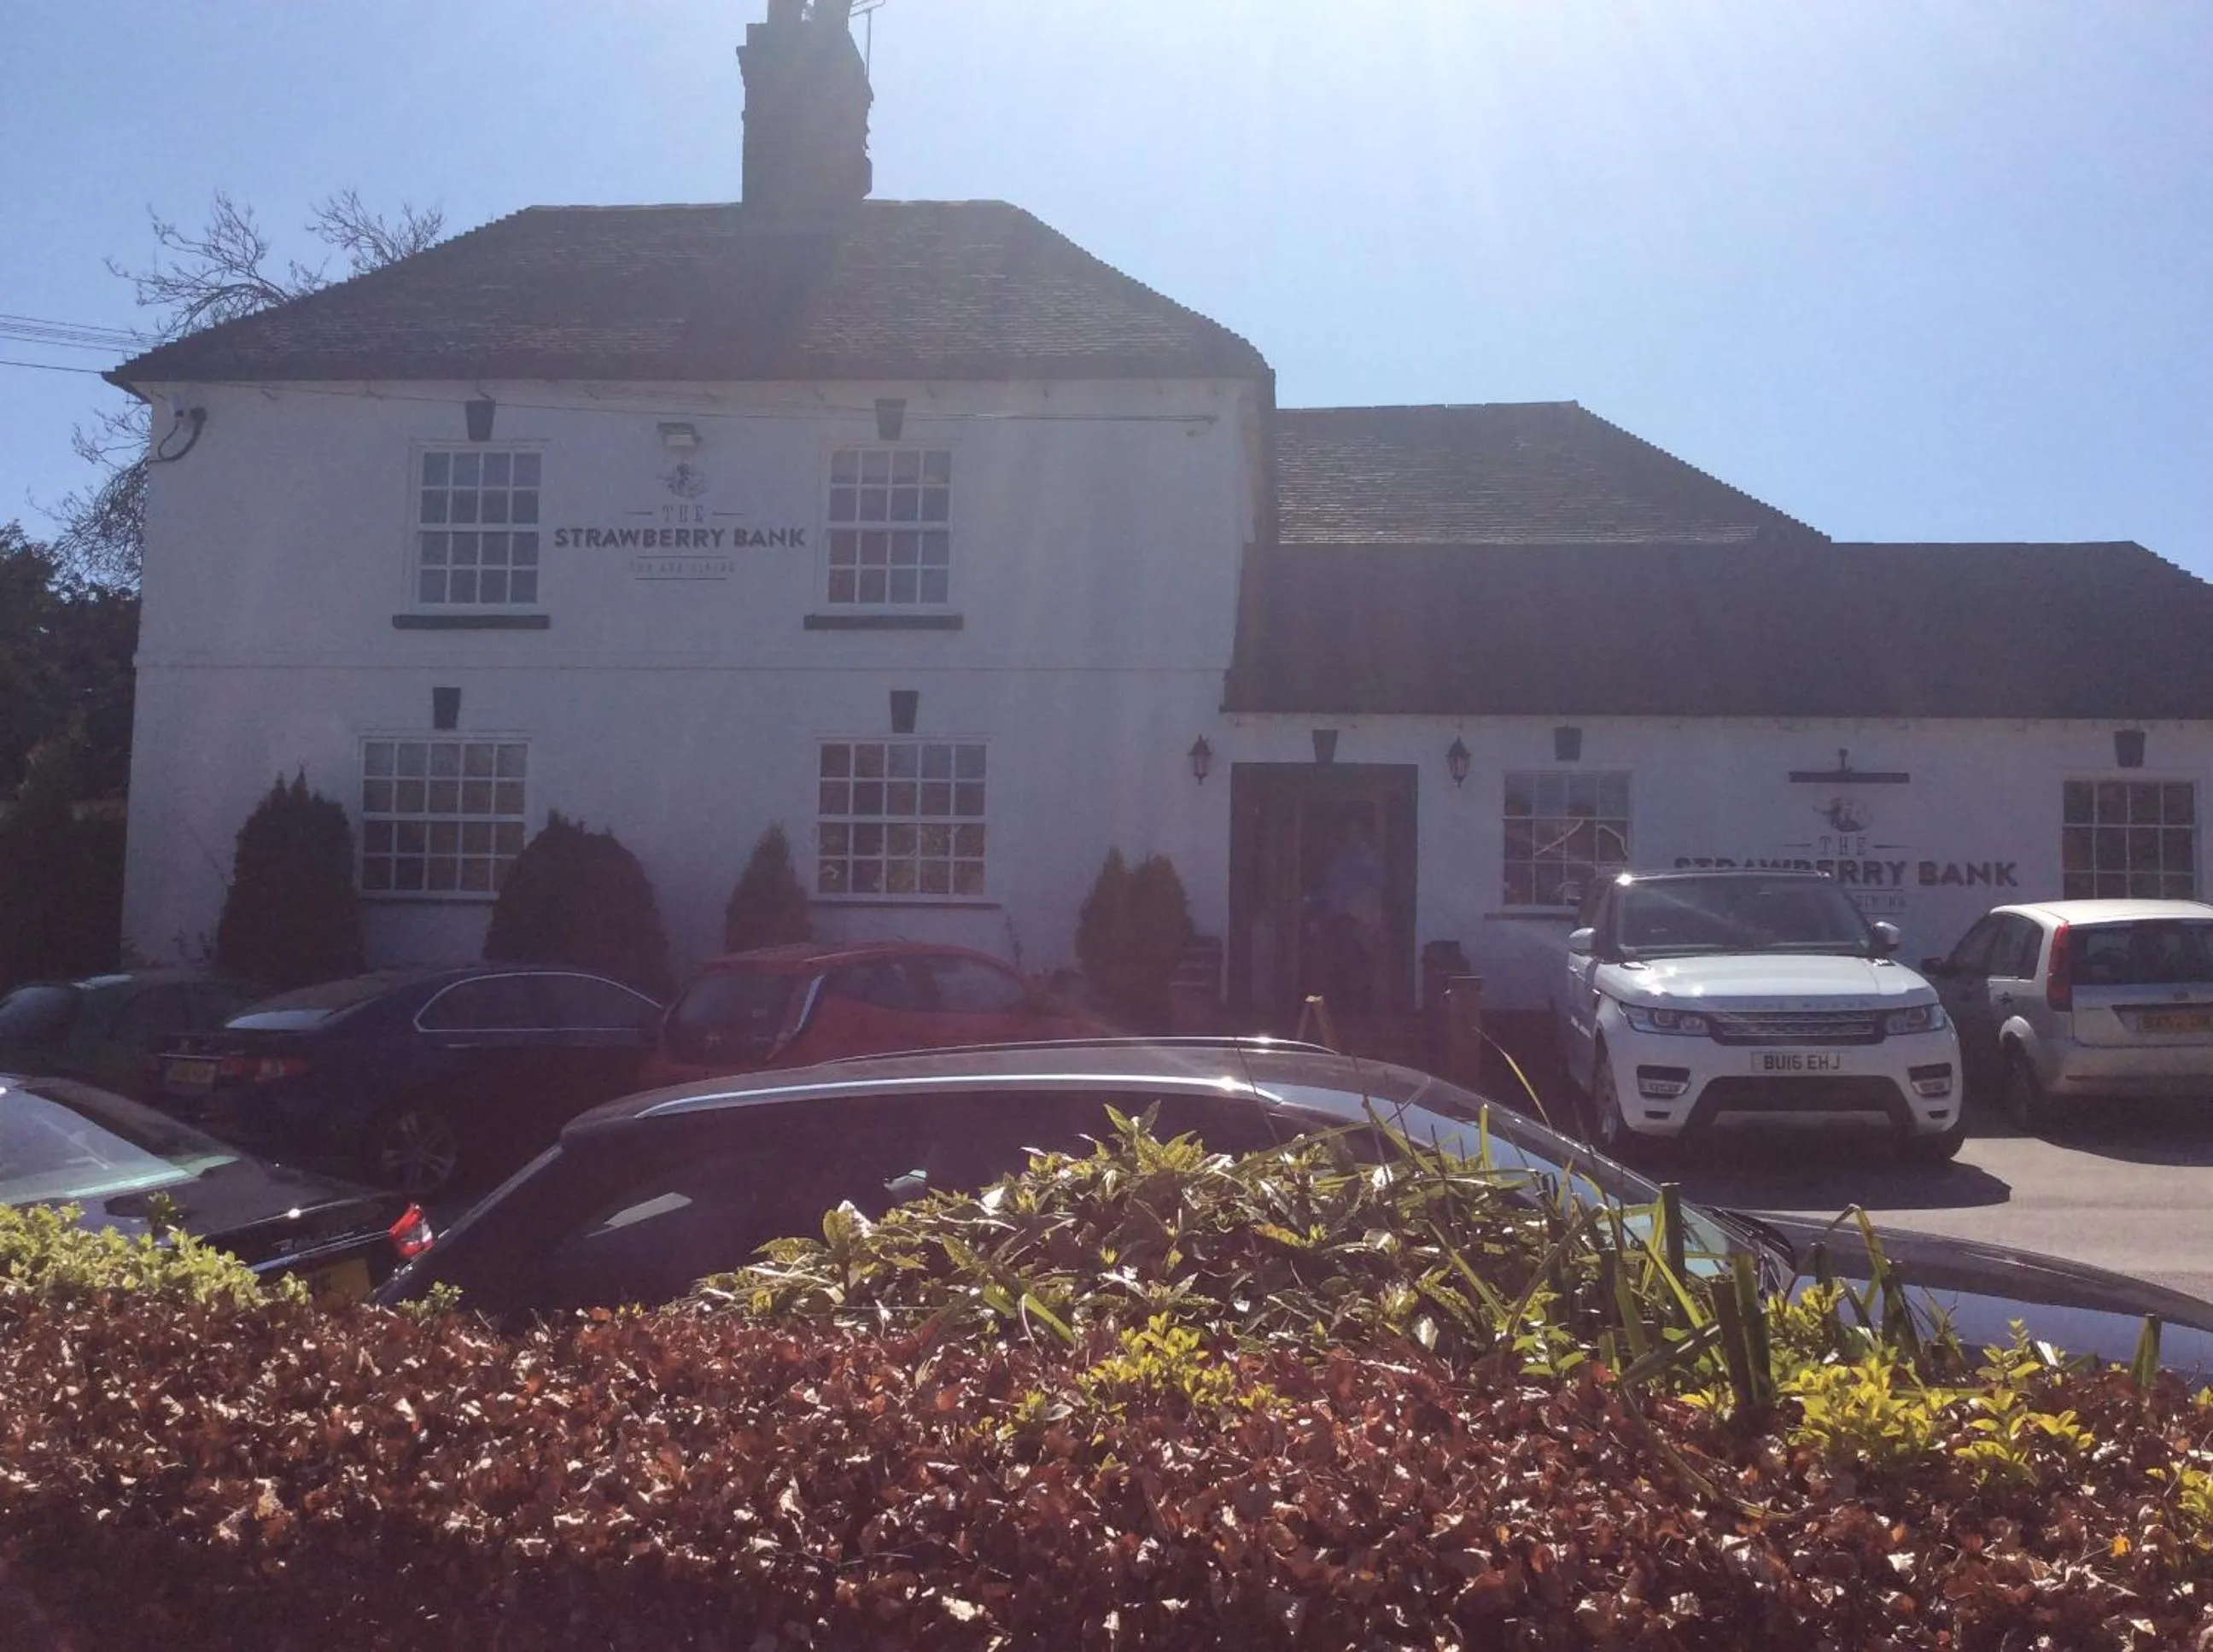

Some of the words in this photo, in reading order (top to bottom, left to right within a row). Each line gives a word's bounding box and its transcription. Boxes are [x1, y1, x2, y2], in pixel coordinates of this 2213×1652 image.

[663, 505, 704, 522] THE
[555, 528, 724, 547] STRAWBERRY
[733, 528, 806, 547] BANK
[1819, 836, 1866, 855] THE
[1918, 861, 2018, 886] BANK
